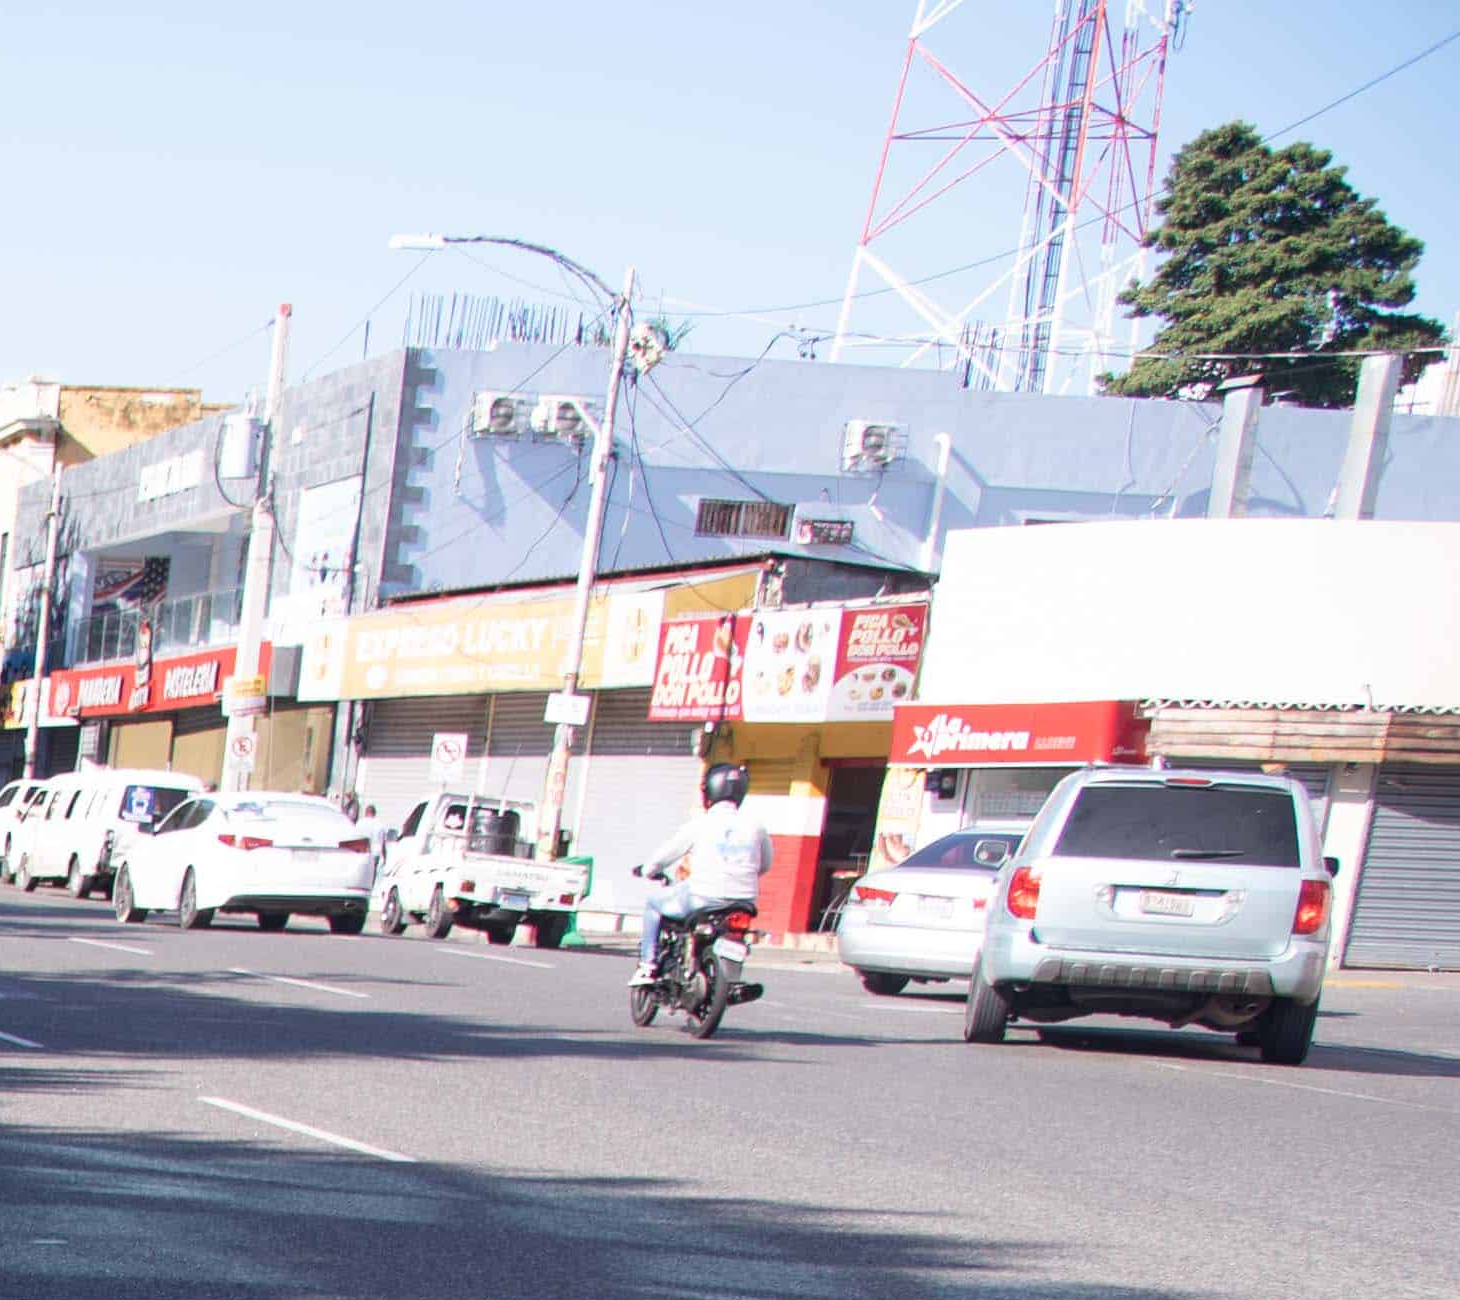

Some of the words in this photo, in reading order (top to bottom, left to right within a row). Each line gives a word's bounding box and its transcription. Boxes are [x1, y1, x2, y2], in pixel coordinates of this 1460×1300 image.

[465, 619, 549, 653] LUCKY
[853, 614, 888, 630] PICA
[664, 623, 700, 655] PICA
[848, 628, 906, 645] POLLO
[875, 642, 919, 656] POLLO
[656, 651, 715, 684] POLLO
[685, 680, 740, 705] POLLO
[932, 725, 1030, 756] primera
